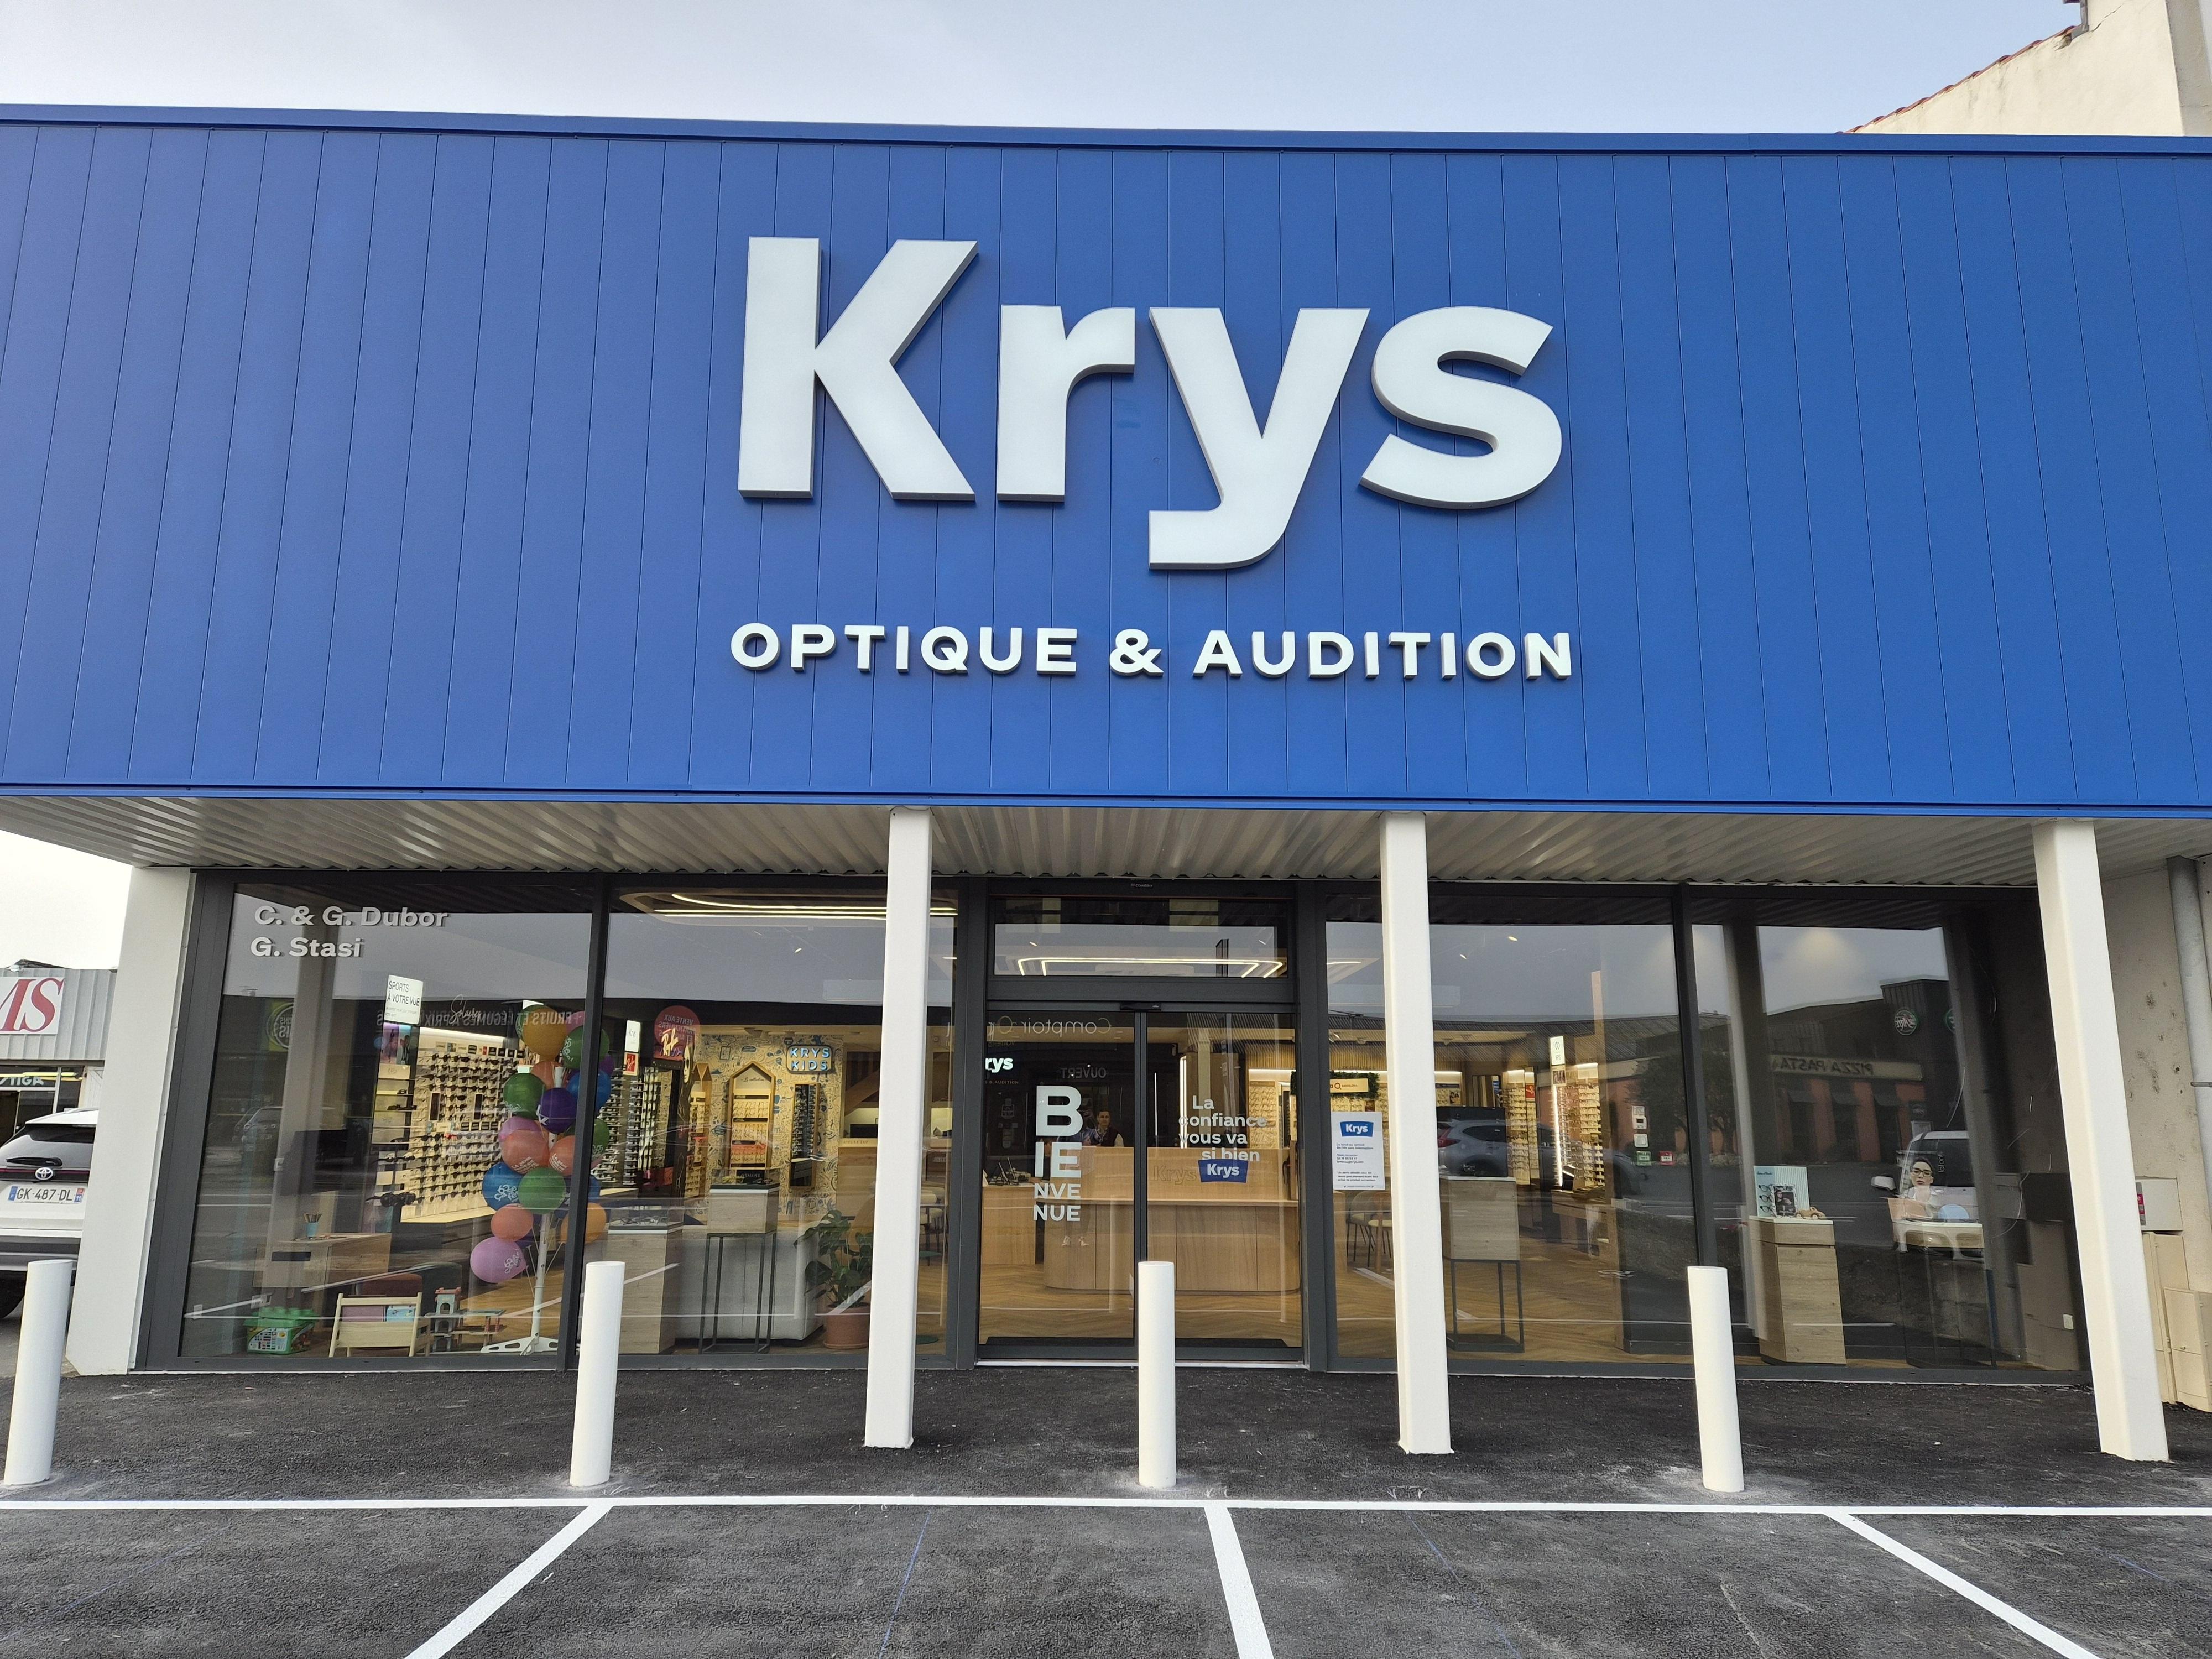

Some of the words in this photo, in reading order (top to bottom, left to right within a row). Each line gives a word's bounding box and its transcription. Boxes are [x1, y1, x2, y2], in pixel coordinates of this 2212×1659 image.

[738, 236, 1563, 571] Krys
[730, 622, 1078, 676] OPTIQUE
[1109, 627, 1163, 677] &
[1193, 630, 1572, 681] AUDITION
[254, 905, 284, 926] C.
[290, 906, 315, 926] &
[322, 906, 353, 926] G.
[361, 907, 449, 927] Dubor
[251, 936, 281, 957] G.
[289, 937, 362, 957] Stasi
[388, 980, 409, 992] SPORTS
[392, 995, 409, 1004] VOTRE
[410, 998, 420, 1006] VUE
[790, 1047, 830, 1058] KRYS
[791, 1060, 828, 1071] KIDS
[1193, 1095, 1215, 1109] La
[1178, 1113, 1268, 1128] confiance
[1345, 1124, 1369, 1134] Krys
[1178, 1133, 1222, 1144] vous
[1225, 1133, 1248, 1144] va
[1202, 1147, 1215, 1160] si
[1221, 1147, 1261, 1161] bien
[1153, 1165, 1197, 1186] Krys
[1207, 1163, 1240, 1178] Krys
[17, 1188, 72, 1201] GK-487-DL
[1034, 1182, 1081, 1199] NVE
[1033, 1204, 1081, 1222] NUE
